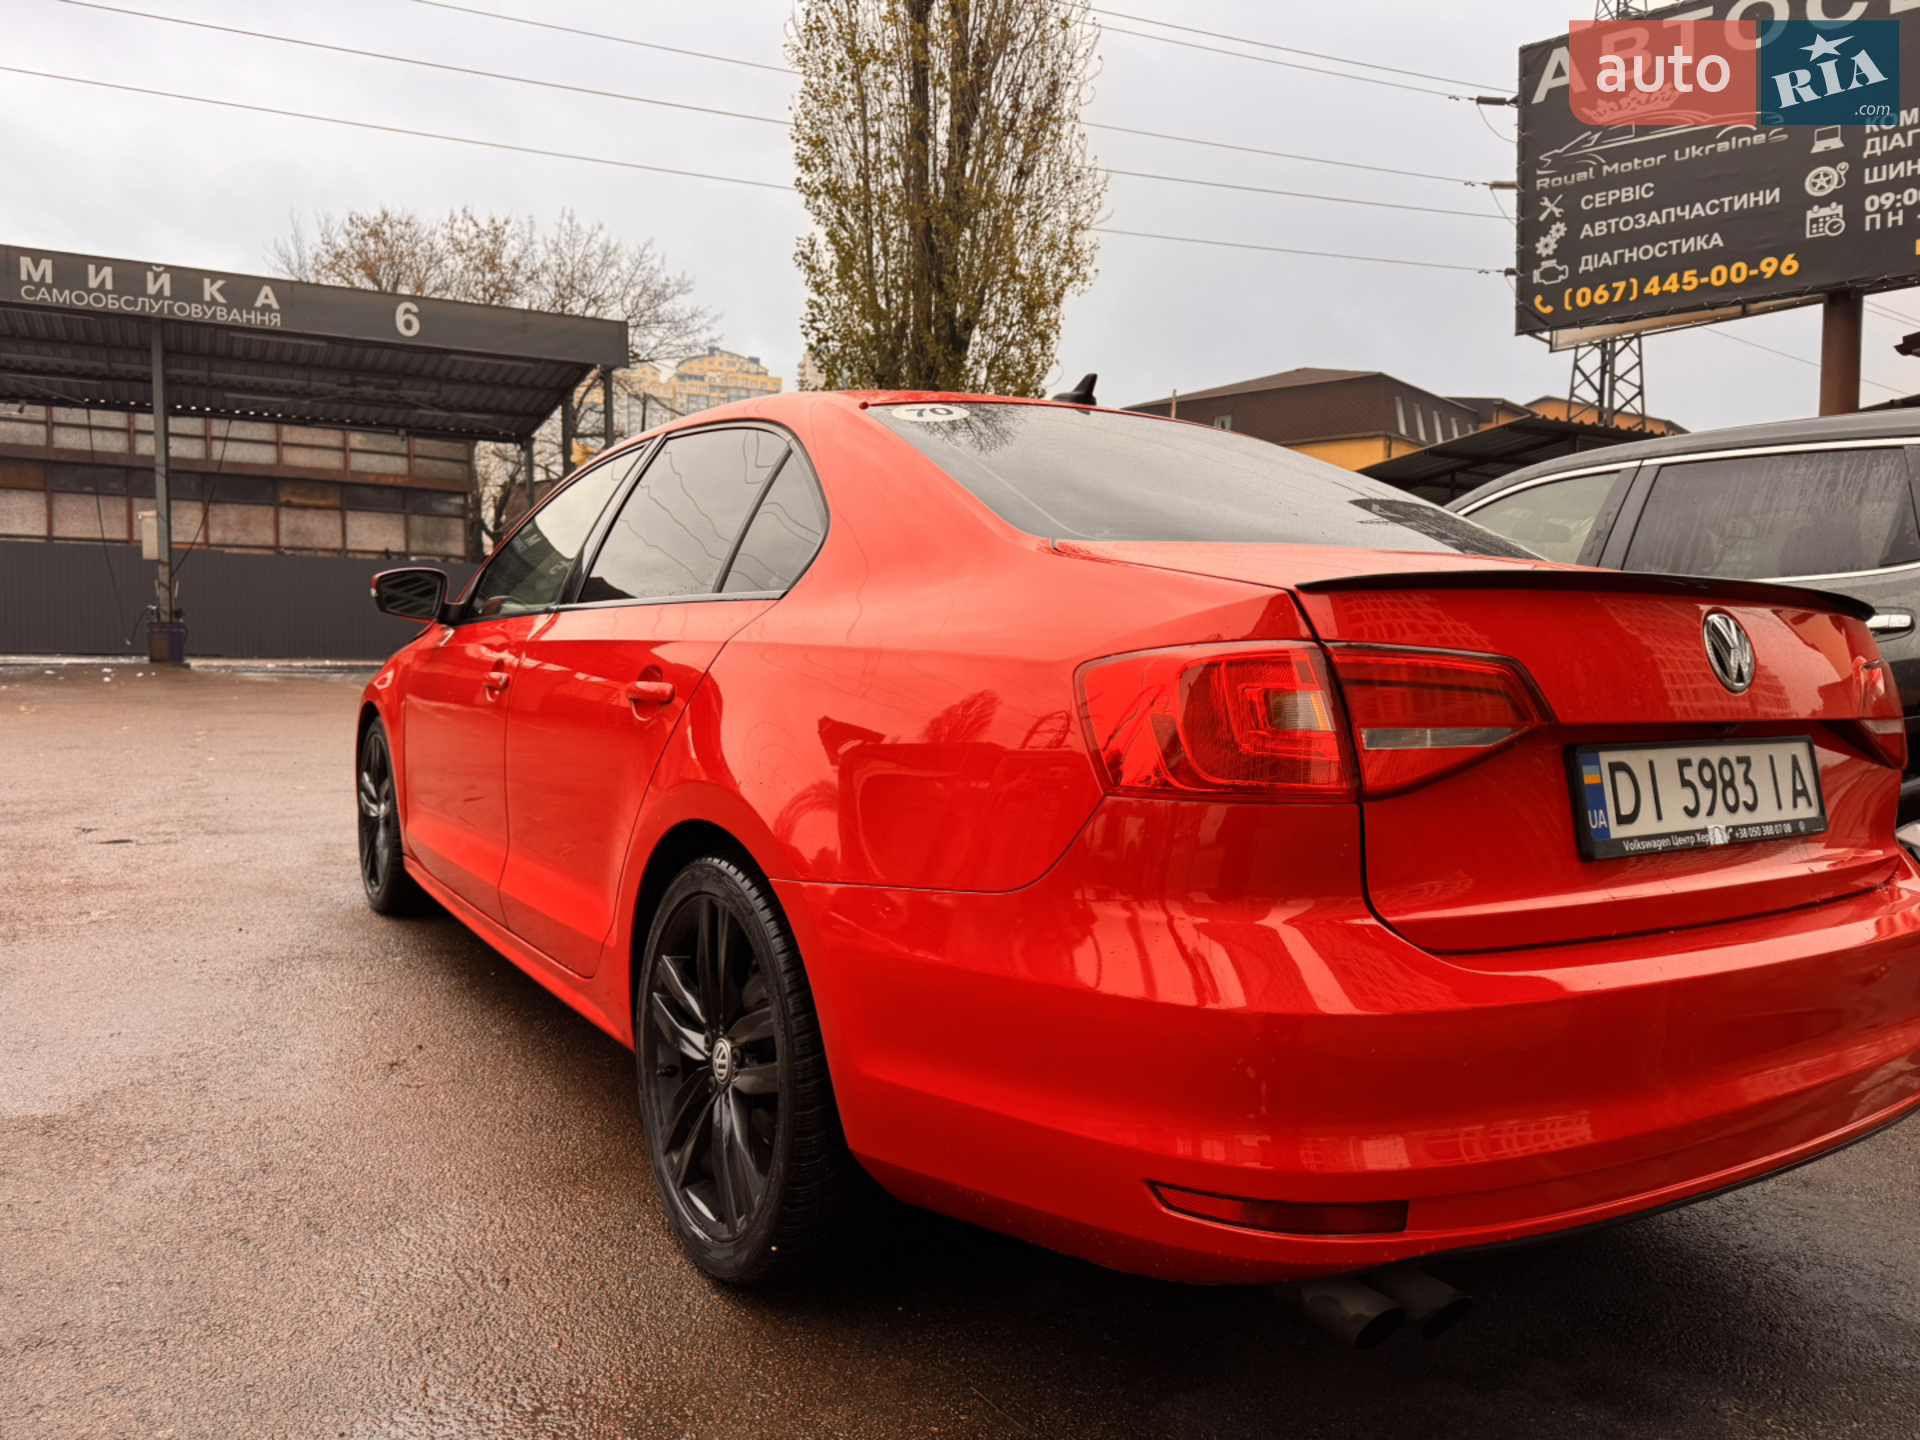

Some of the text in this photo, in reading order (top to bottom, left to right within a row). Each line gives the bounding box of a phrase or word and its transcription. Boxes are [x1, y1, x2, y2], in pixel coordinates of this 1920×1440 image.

[1602, 154, 1667, 177] Motor
[1579, 187, 1781, 240] АВТОЗАПЧАСТИНИ
[1580, 182, 1655, 211] СЕРВІС
[1864, 188, 1920, 212] 09:0
[1579, 232, 1724, 274] ДІАГНОСТИКА
[19, 255, 281, 310] МИЙКА
[1564, 253, 1800, 311] (067) 445-00-96
[20, 284, 282, 327] САМООБСЛУГОВУВАННЯ
[394, 301, 421, 337] 6
[1607, 759, 1663, 825] DI
[1676, 755, 1758, 818] 5983
[1587, 809, 1608, 830] UA
[1622, 838, 1672, 851] Volkswagen
